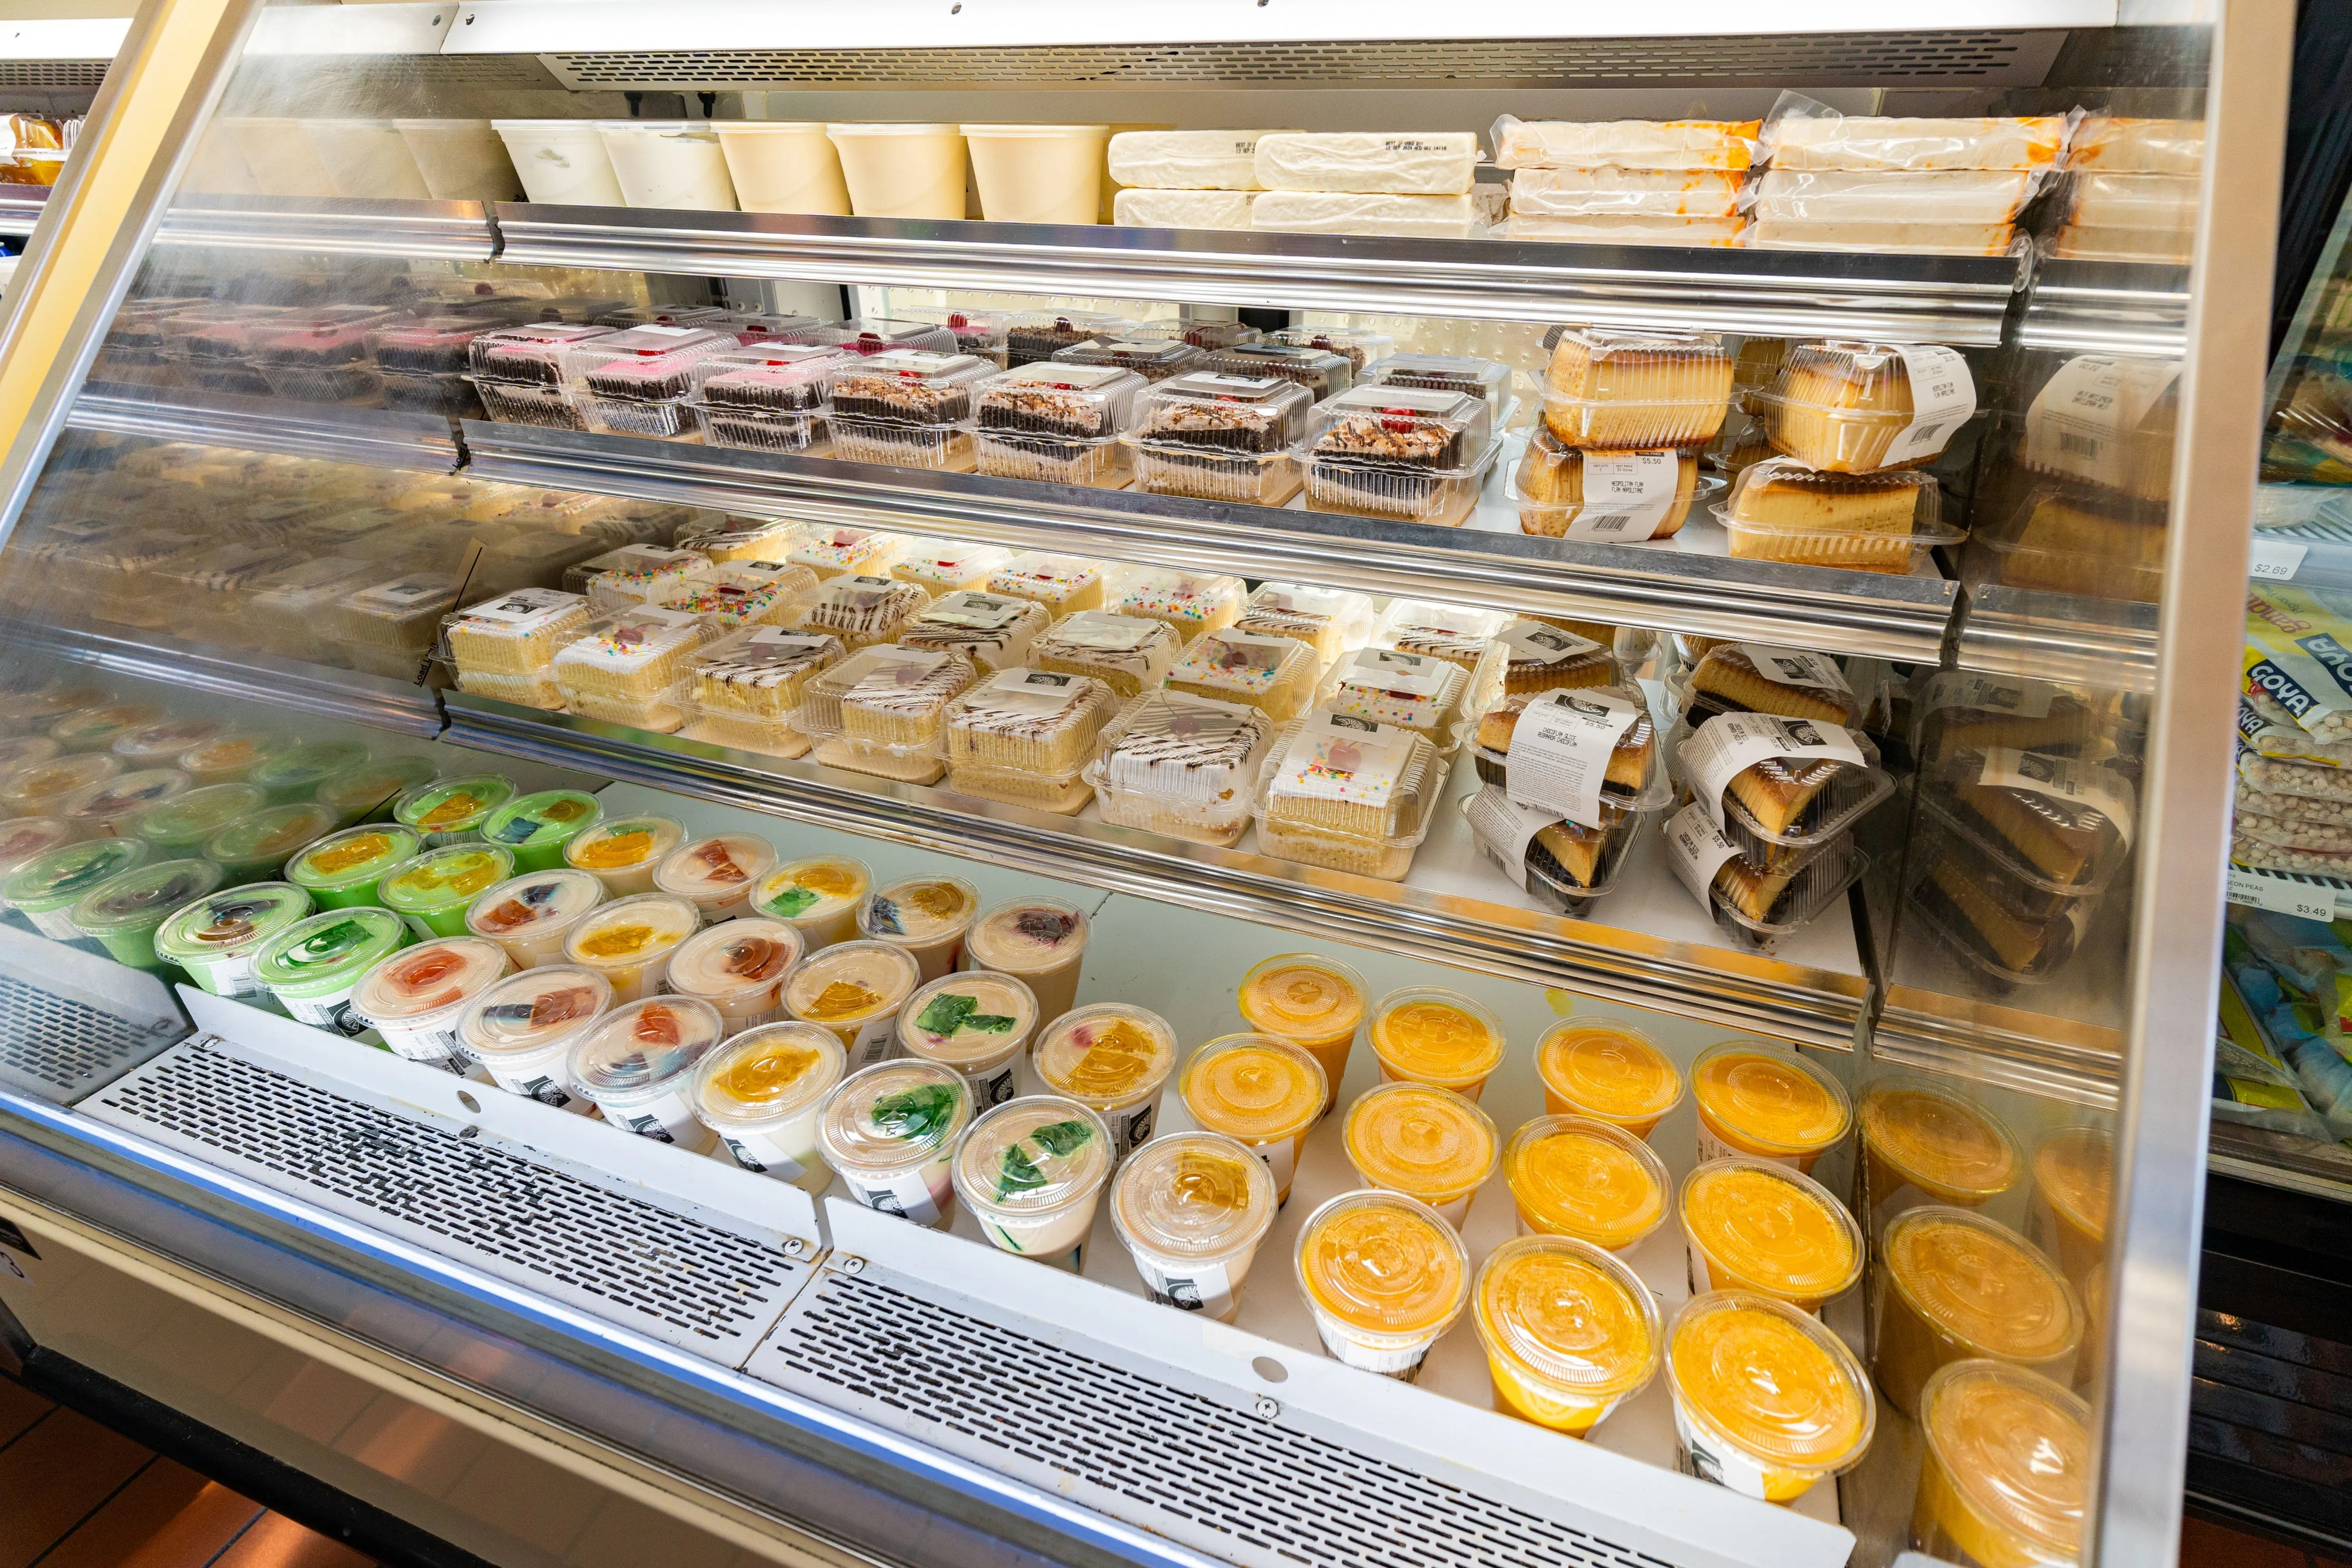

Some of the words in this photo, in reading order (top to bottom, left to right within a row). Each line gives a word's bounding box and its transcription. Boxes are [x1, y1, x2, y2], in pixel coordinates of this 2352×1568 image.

[2254, 564, 2288, 575] $2.69
[413, 664, 427, 686] Load
[2251, 666, 2309, 714] GOYA
[1585, 720, 1606, 730] $5.50
[1538, 731, 1556, 741] REBANADA
[1556, 737, 1578, 748] CHOCOFLAN
[1542, 727, 1563, 737] CHOCOFLAN
[1564, 733, 1576, 741] SLICE
[1712, 835, 1725, 849] $5.50
[2245, 884, 2264, 892] PEAS
[2296, 904, 2327, 917] $3.49
